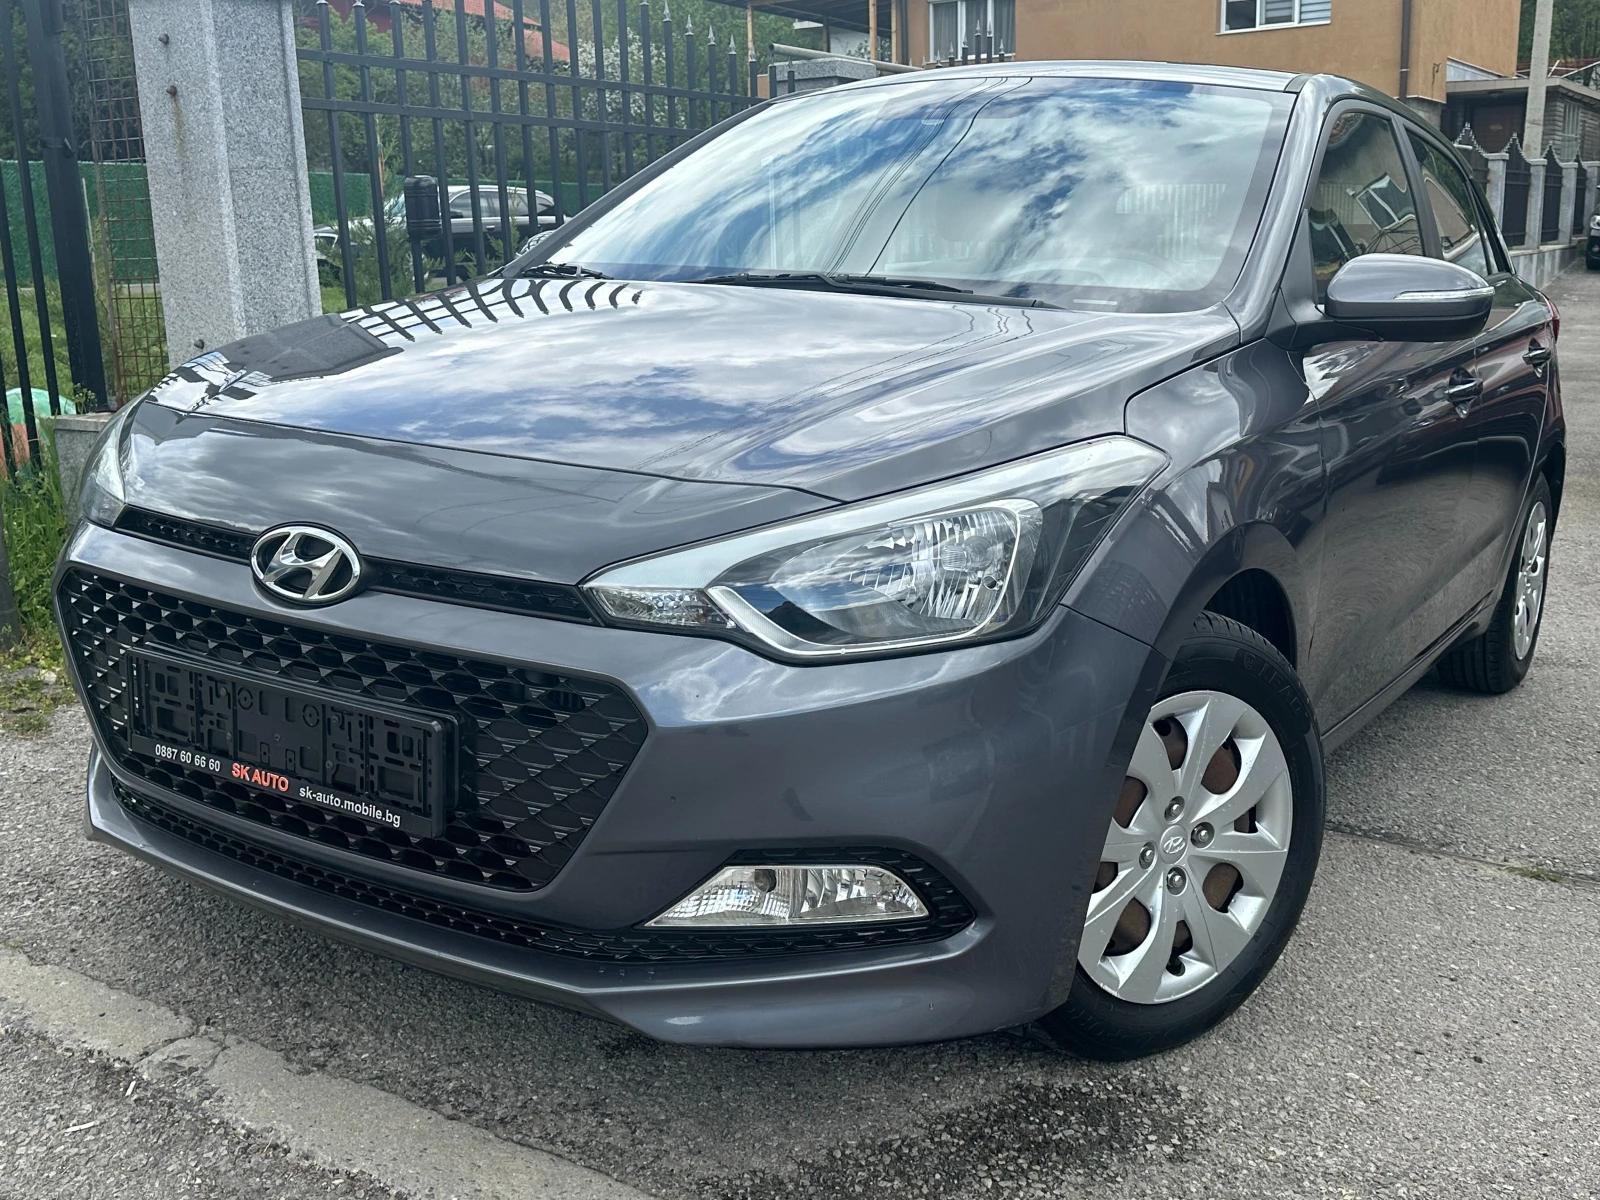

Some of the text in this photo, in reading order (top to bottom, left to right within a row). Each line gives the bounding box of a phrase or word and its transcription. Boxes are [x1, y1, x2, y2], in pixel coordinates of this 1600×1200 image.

[155, 743, 221, 772] 0887 60 66 60
[231, 762, 289, 792] SK AUTO
[299, 786, 401, 828] sk-auto.mobile.bg
